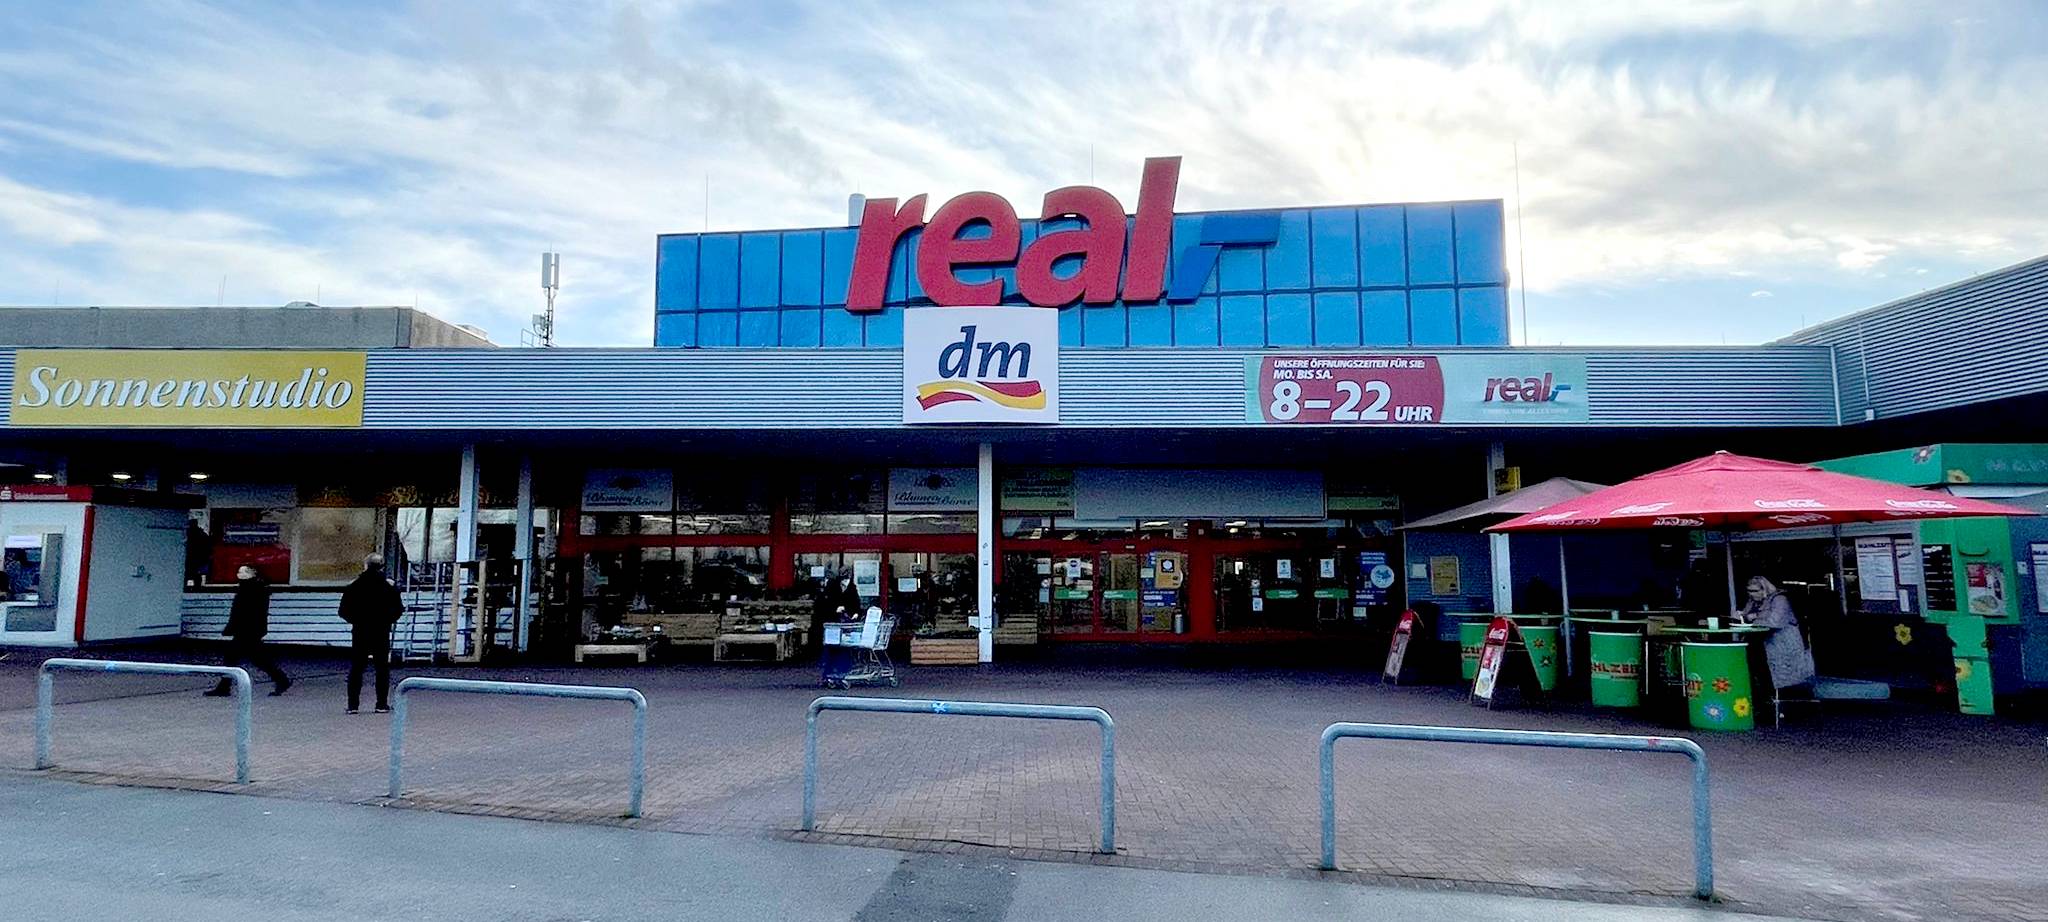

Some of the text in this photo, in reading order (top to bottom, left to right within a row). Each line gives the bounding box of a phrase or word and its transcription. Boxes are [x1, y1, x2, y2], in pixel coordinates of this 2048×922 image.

[938, 325, 1031, 379] dm
[1274, 359, 1309, 368] UNSERE
[1310, 357, 1388, 369] ÖFFNUNGSZEITEN
[1388, 357, 1408, 369] FÜR
[1273, 369, 1334, 380] MO. BIS SA.
[20, 366, 354, 410] Sonnenstudio
[1394, 406, 1433, 422] UHR
